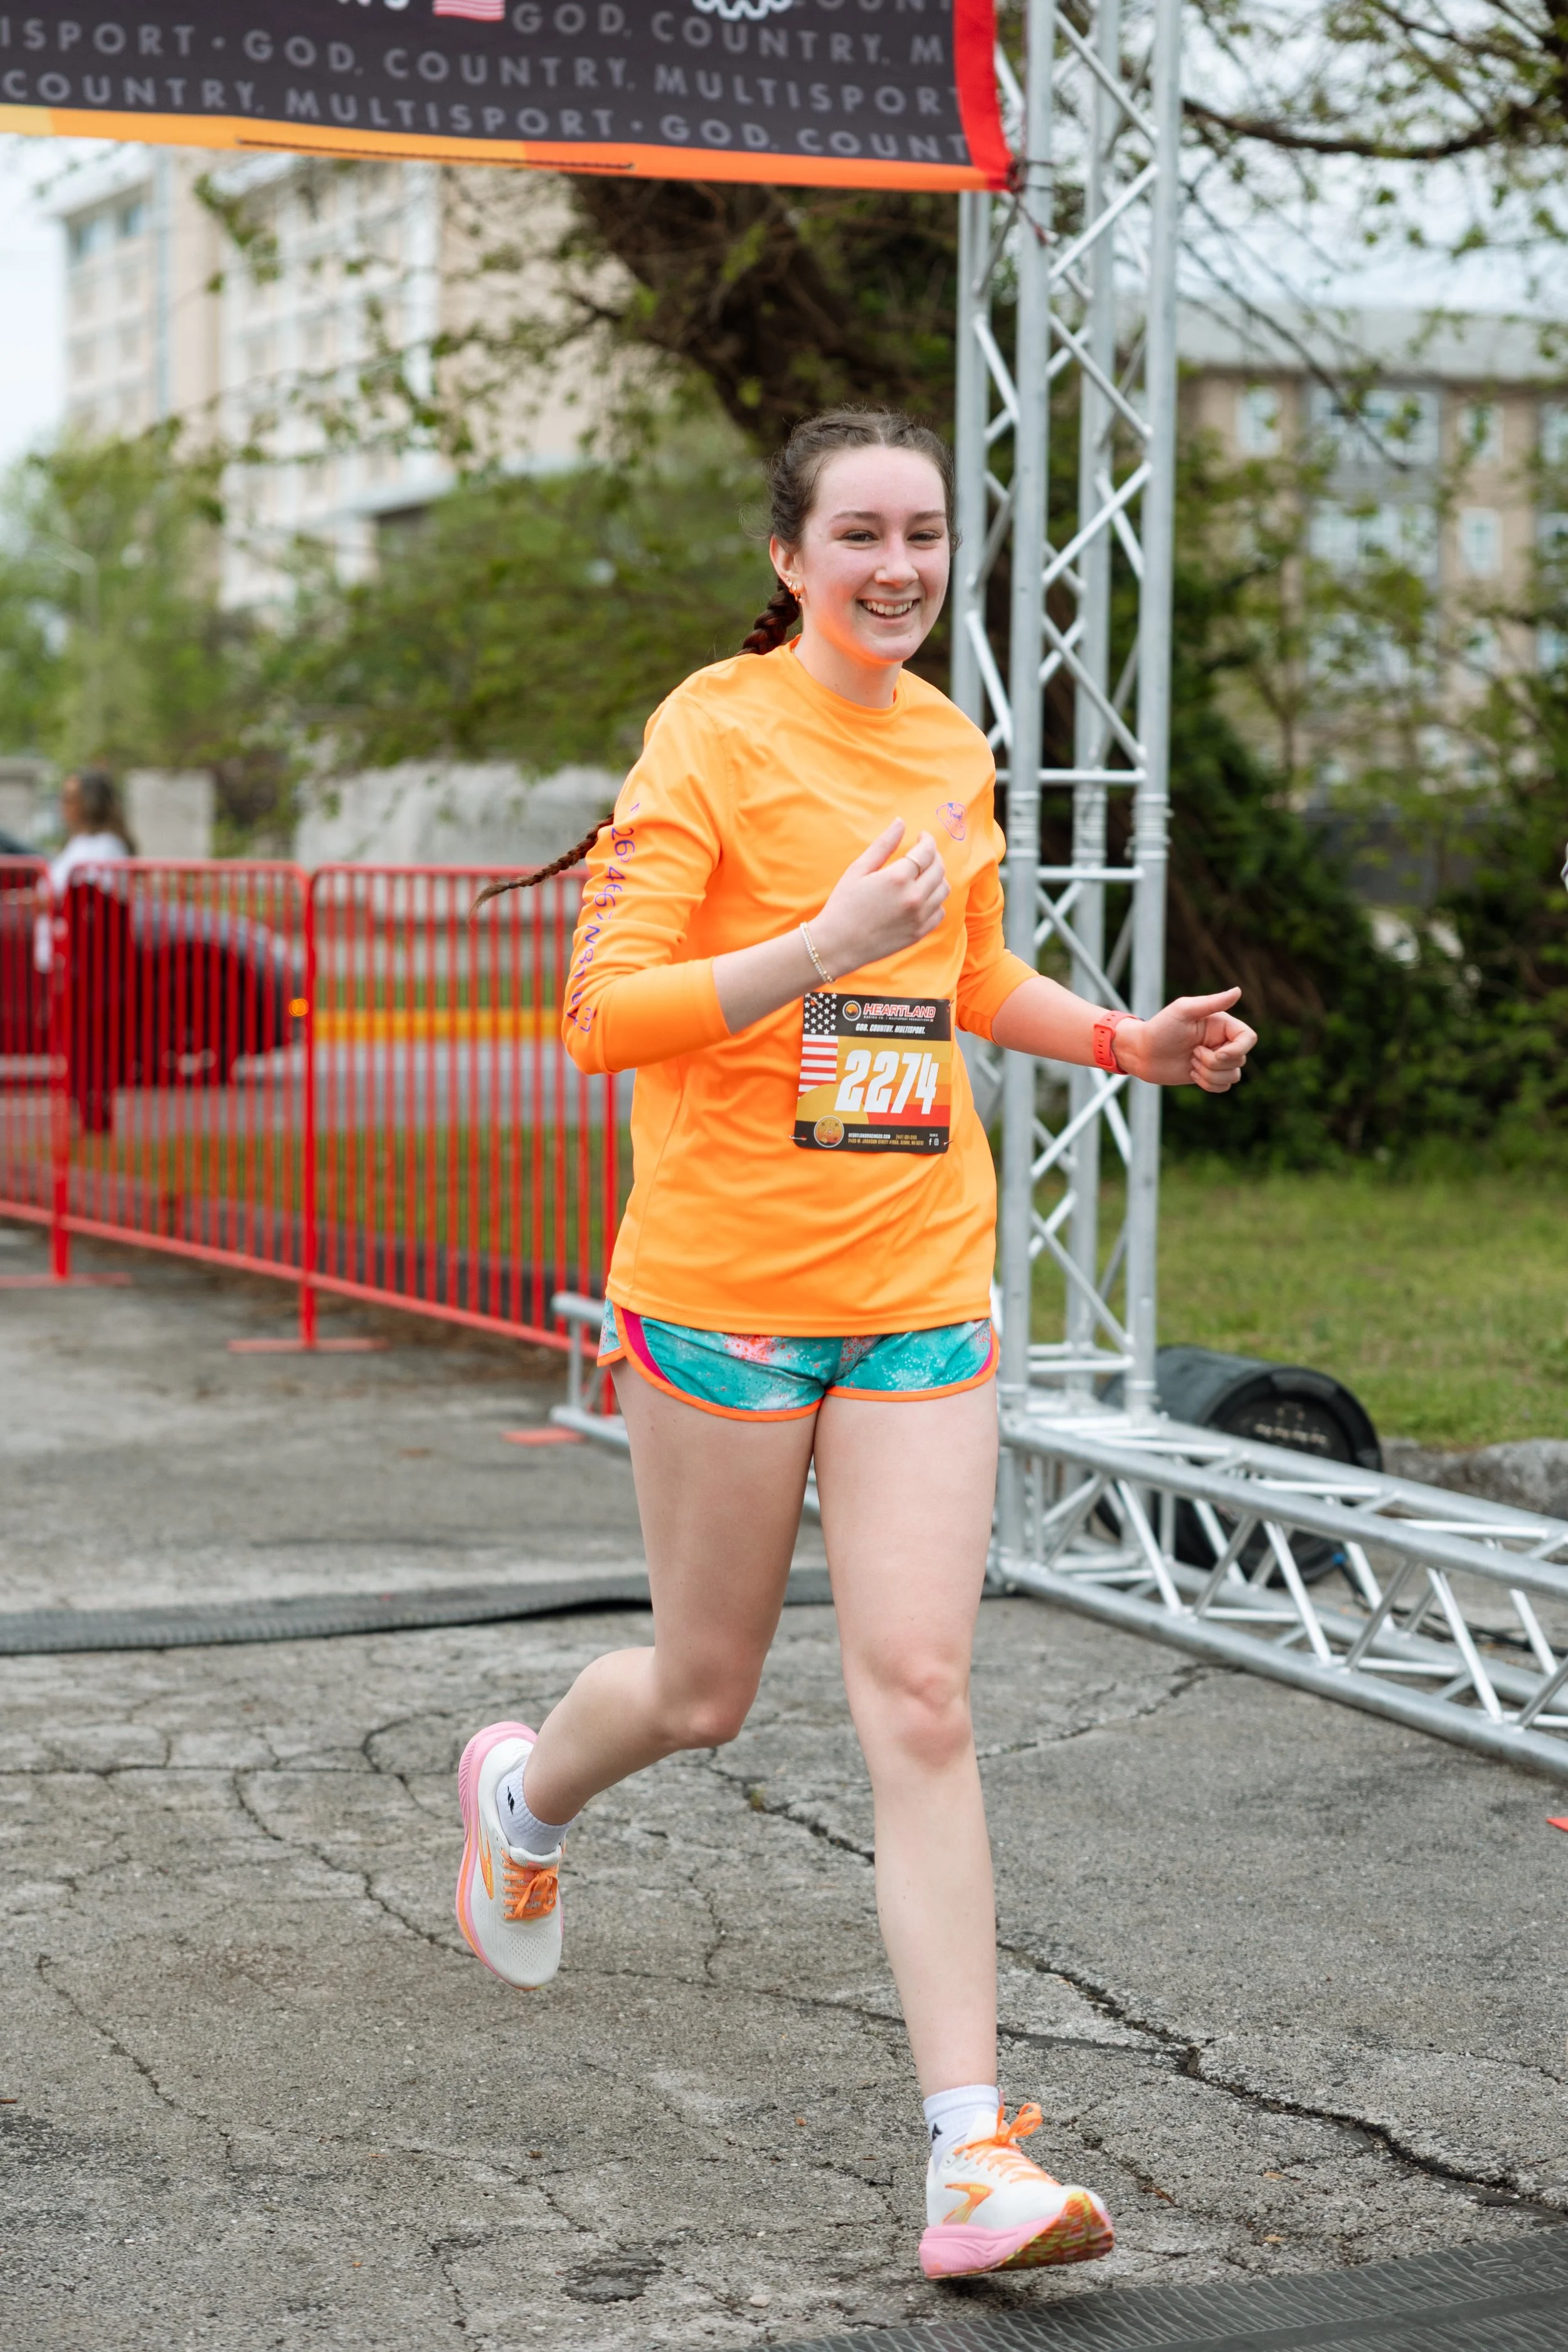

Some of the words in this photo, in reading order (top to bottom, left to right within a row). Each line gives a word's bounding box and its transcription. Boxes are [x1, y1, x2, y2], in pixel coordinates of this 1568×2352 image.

[285, 87, 614, 137] MULTISPORT
[796, 127, 969, 161] COUNT
[856, 1023, 869, 1032] GOD.
[869, 1024, 894, 1032] COUNTRY.
[894, 1025, 926, 1034] MULTISPORT.
[863, 1003, 936, 1019] HEARTLAND
[834, 1049, 940, 1115] 2274
